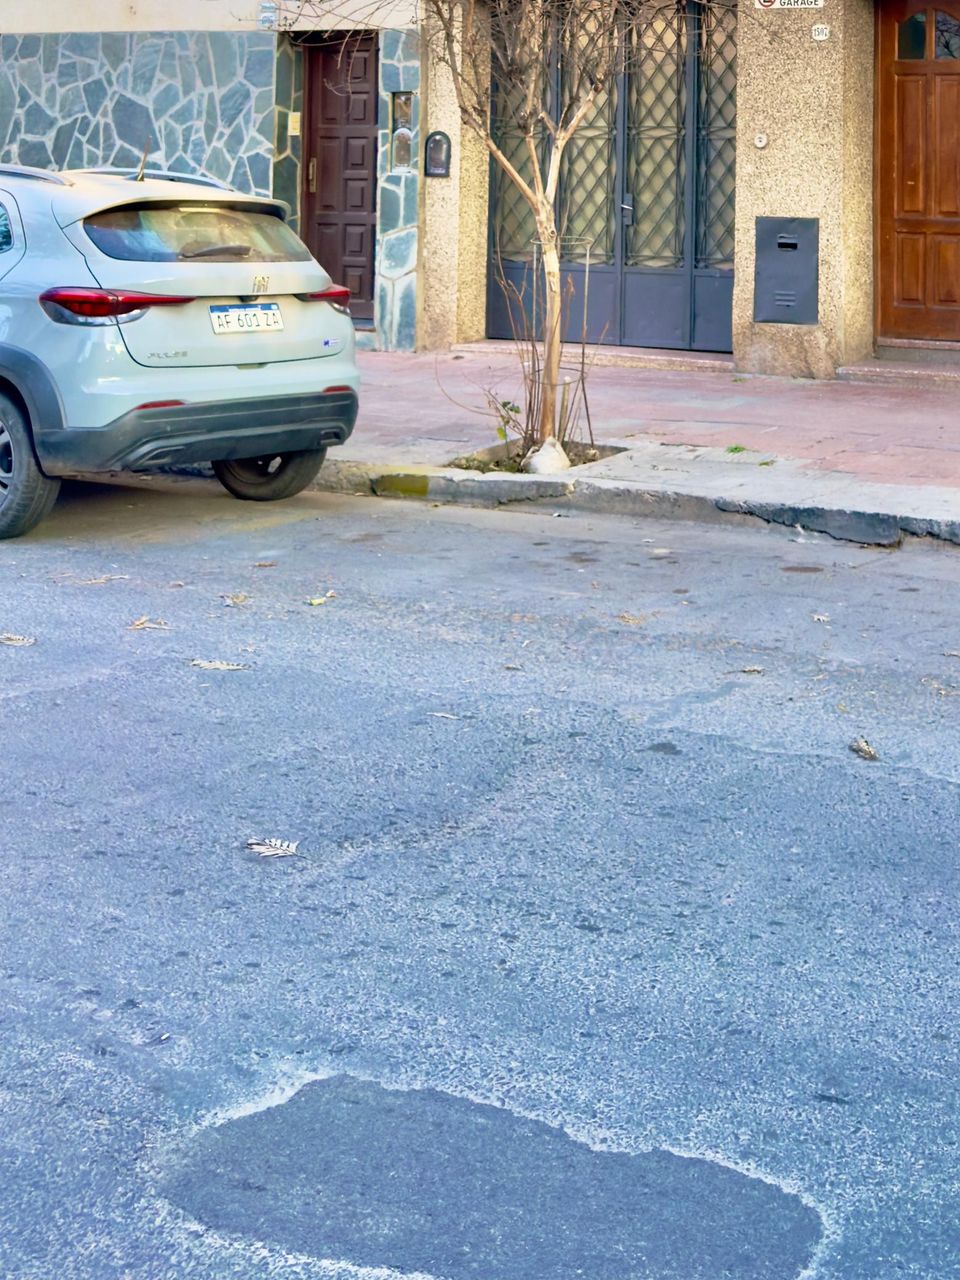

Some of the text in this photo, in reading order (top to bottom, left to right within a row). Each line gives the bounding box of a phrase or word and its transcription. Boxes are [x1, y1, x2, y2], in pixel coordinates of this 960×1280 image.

[217, 312, 280, 329] AF 601 ZA
